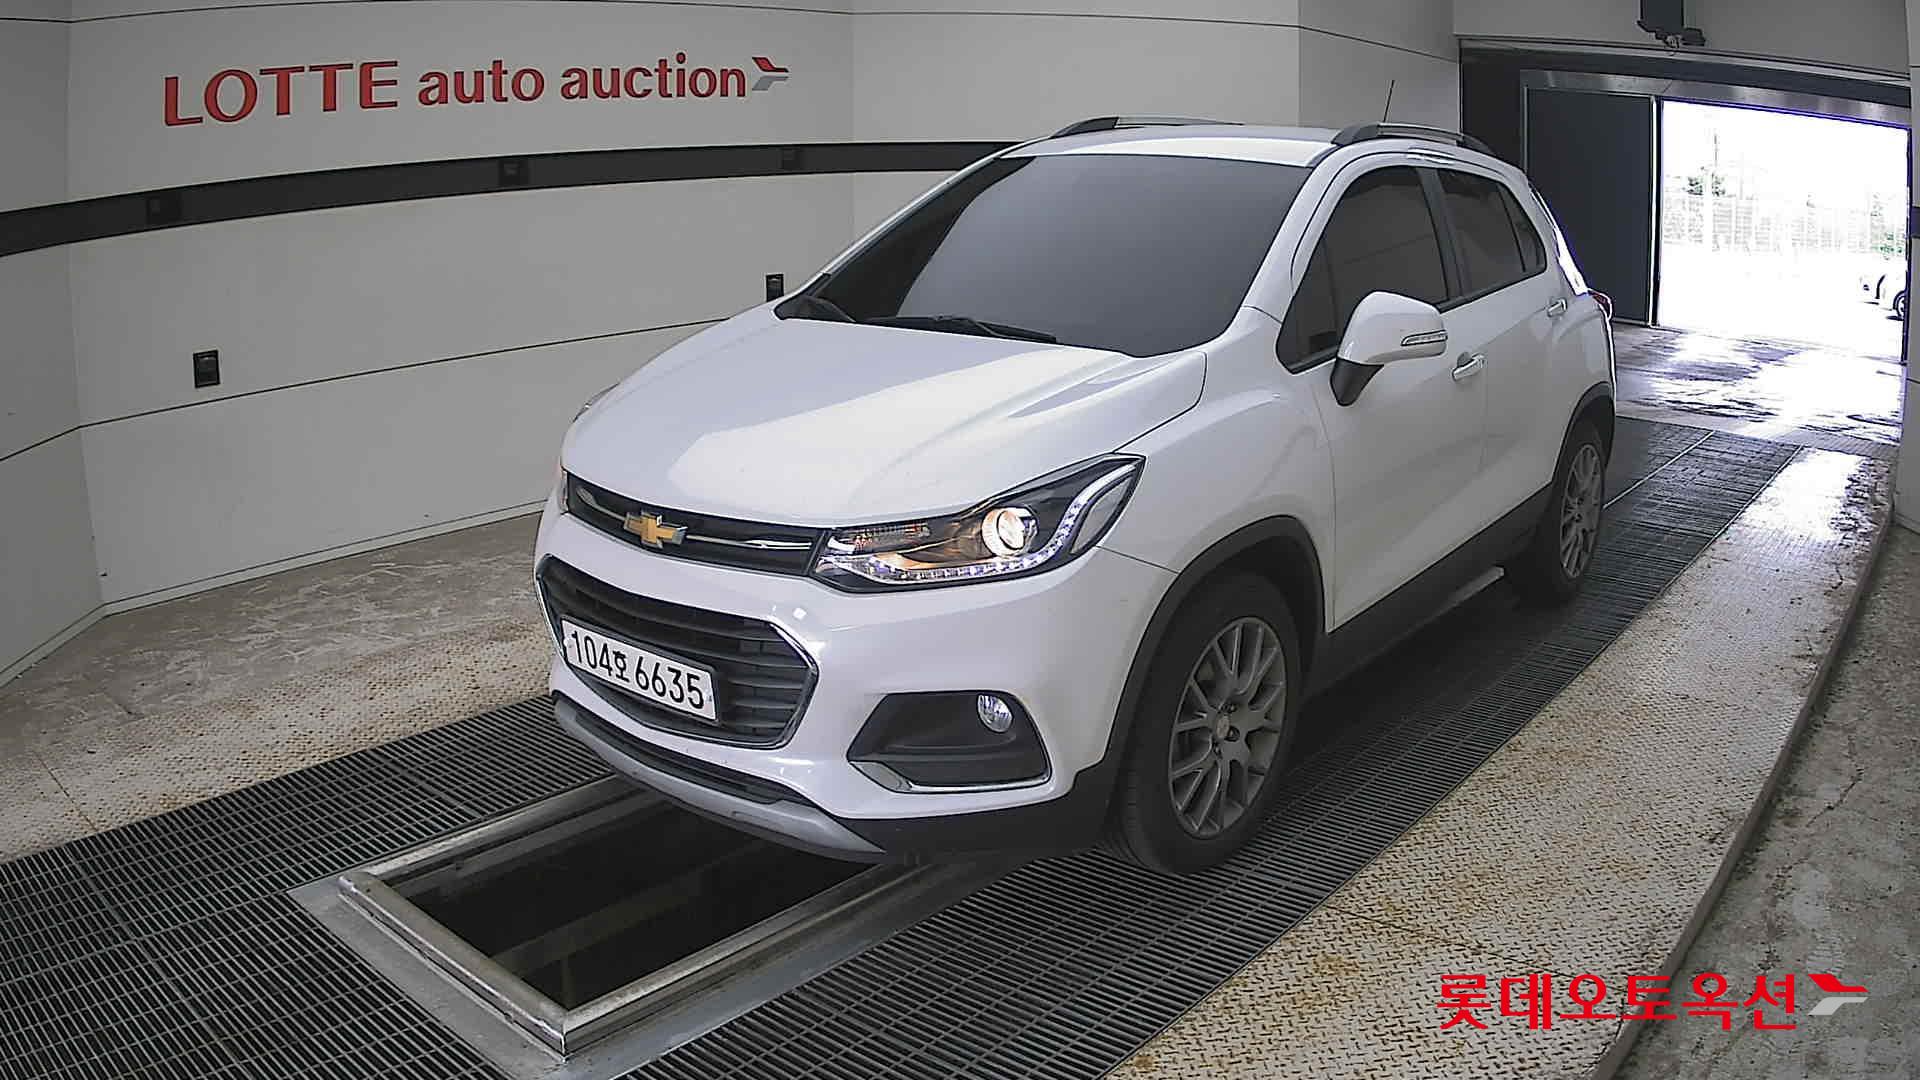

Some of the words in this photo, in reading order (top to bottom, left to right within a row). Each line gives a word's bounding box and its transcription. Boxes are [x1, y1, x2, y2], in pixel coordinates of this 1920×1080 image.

[163, 60, 399, 127] LOTTE
[417, 59, 545, 105] auto
[560, 52, 747, 100] auction
[571, 630, 630, 683] 104호
[635, 655, 704, 709] 6635
